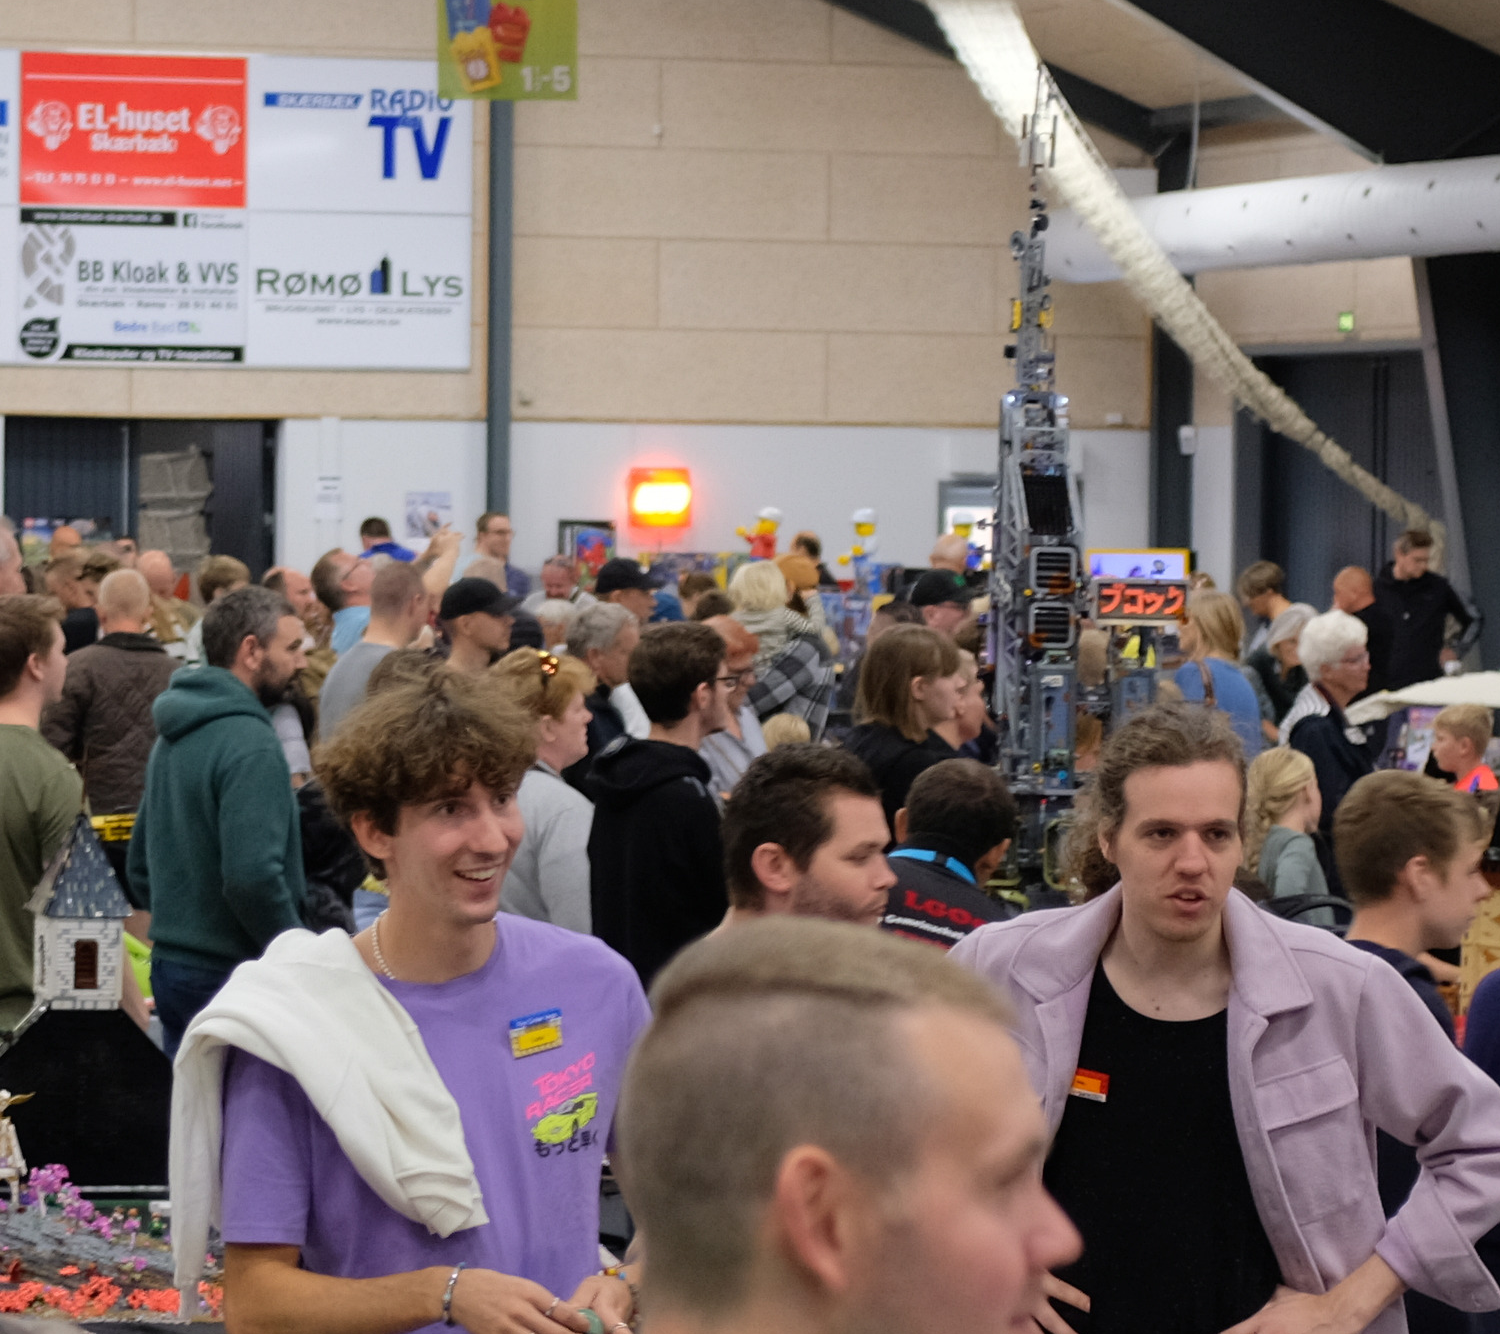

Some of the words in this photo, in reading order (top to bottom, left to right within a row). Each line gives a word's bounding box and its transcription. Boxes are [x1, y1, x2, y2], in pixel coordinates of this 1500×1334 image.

[76, 101, 191, 134] EL-huset
[367, 114, 453, 181] TV
[77, 260, 105, 283] BB
[112, 260, 169, 284] Kloak
[176, 262, 190, 284] &
[198, 263, 239, 285] VVS
[525, 1071, 594, 1120] RACER
[532, 1051, 597, 1097] TOKYO
